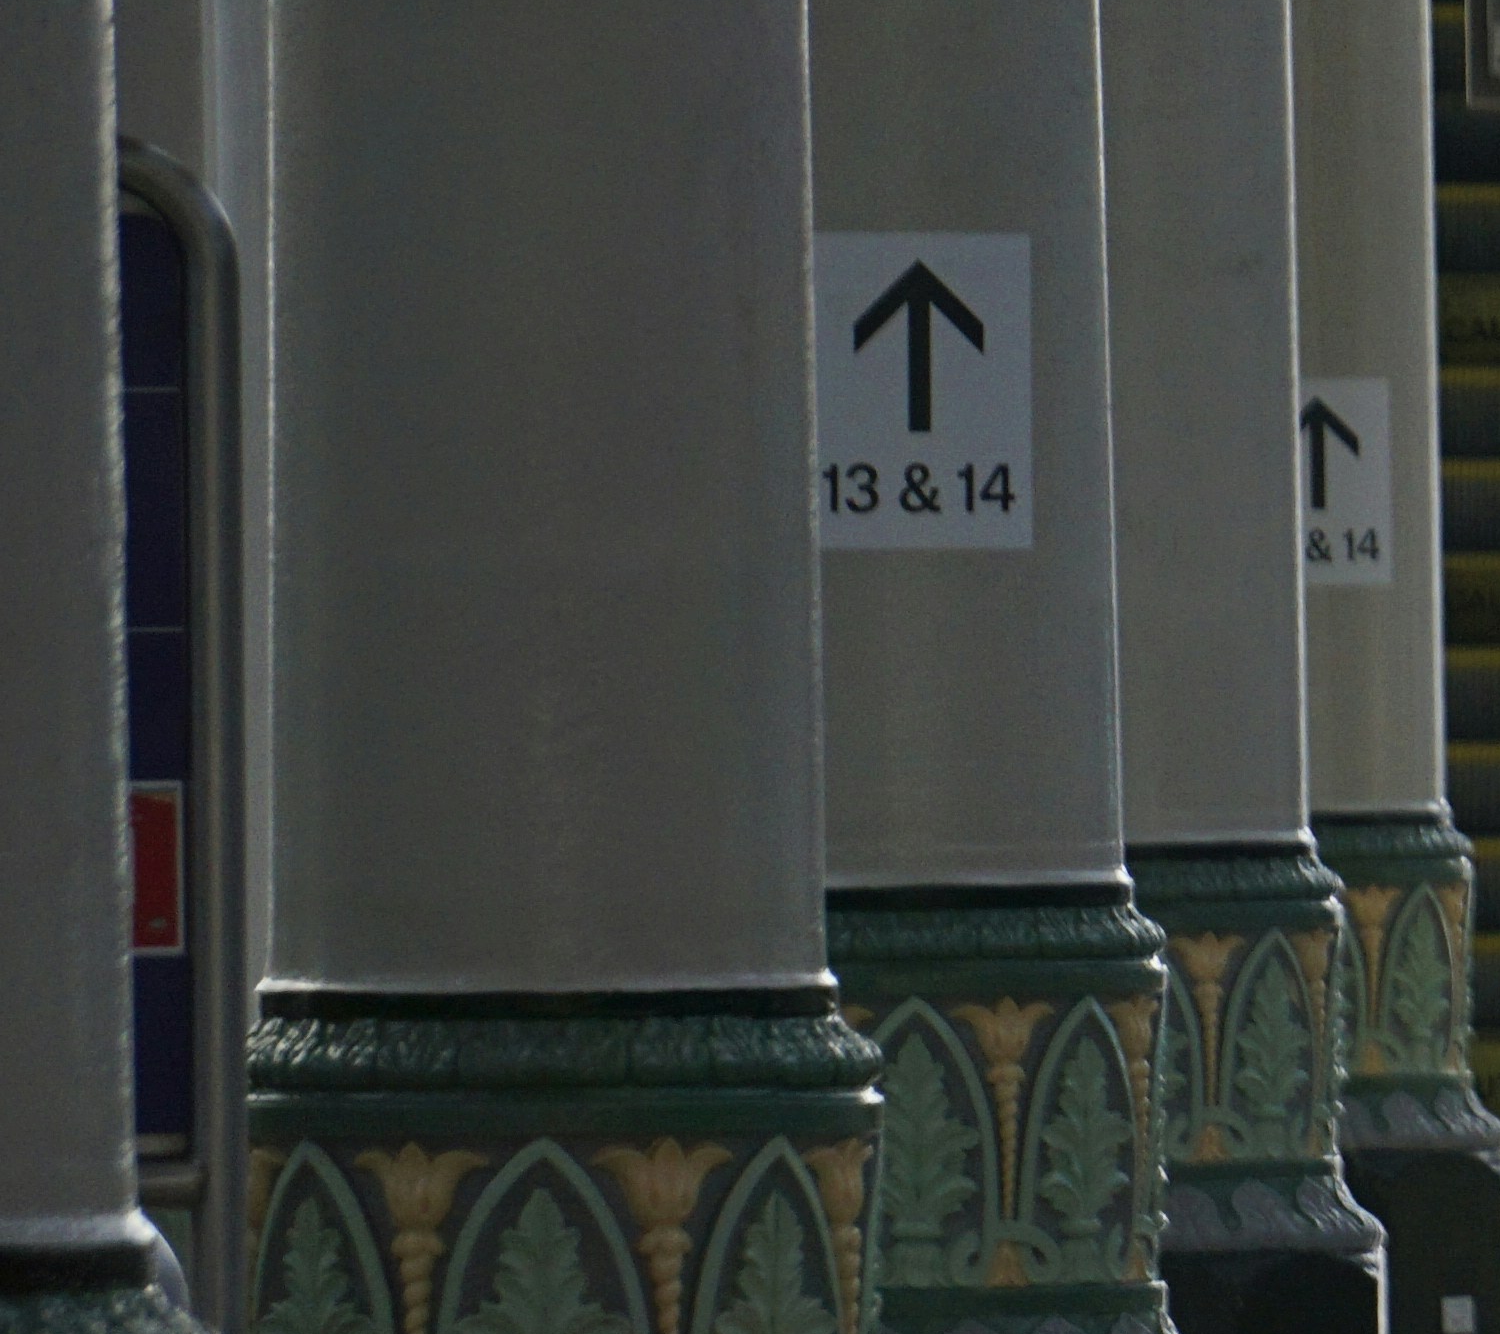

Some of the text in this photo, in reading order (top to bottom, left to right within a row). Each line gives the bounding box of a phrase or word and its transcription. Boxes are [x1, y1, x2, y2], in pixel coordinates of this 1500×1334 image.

[823, 463, 1015, 514] 13 & 14
[1305, 528, 1379, 562] & 14
